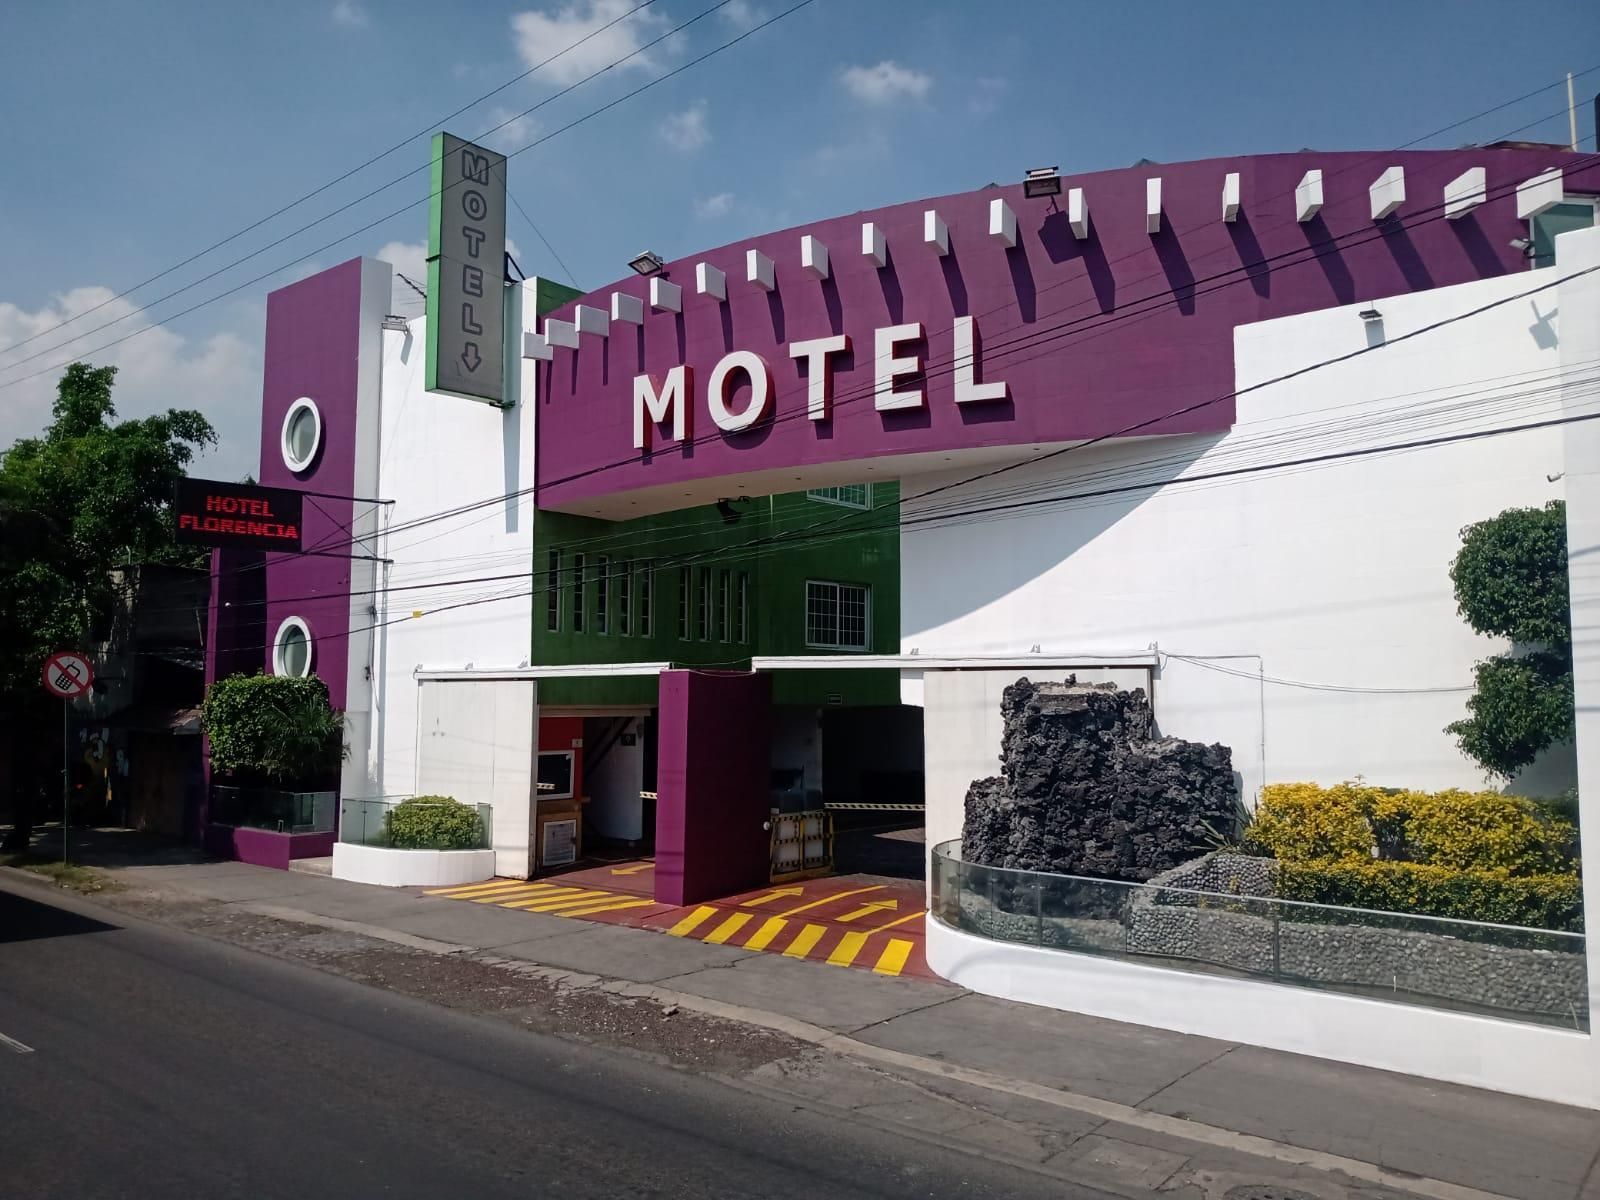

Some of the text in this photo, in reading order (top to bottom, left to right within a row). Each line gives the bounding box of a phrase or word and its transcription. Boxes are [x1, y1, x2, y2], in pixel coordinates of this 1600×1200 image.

[462, 150, 489, 336] MOTEL
[633, 315, 1008, 449] MOTEL
[180, 514, 298, 539] FLORENCIA
[206, 495, 274, 517] HOTEL
